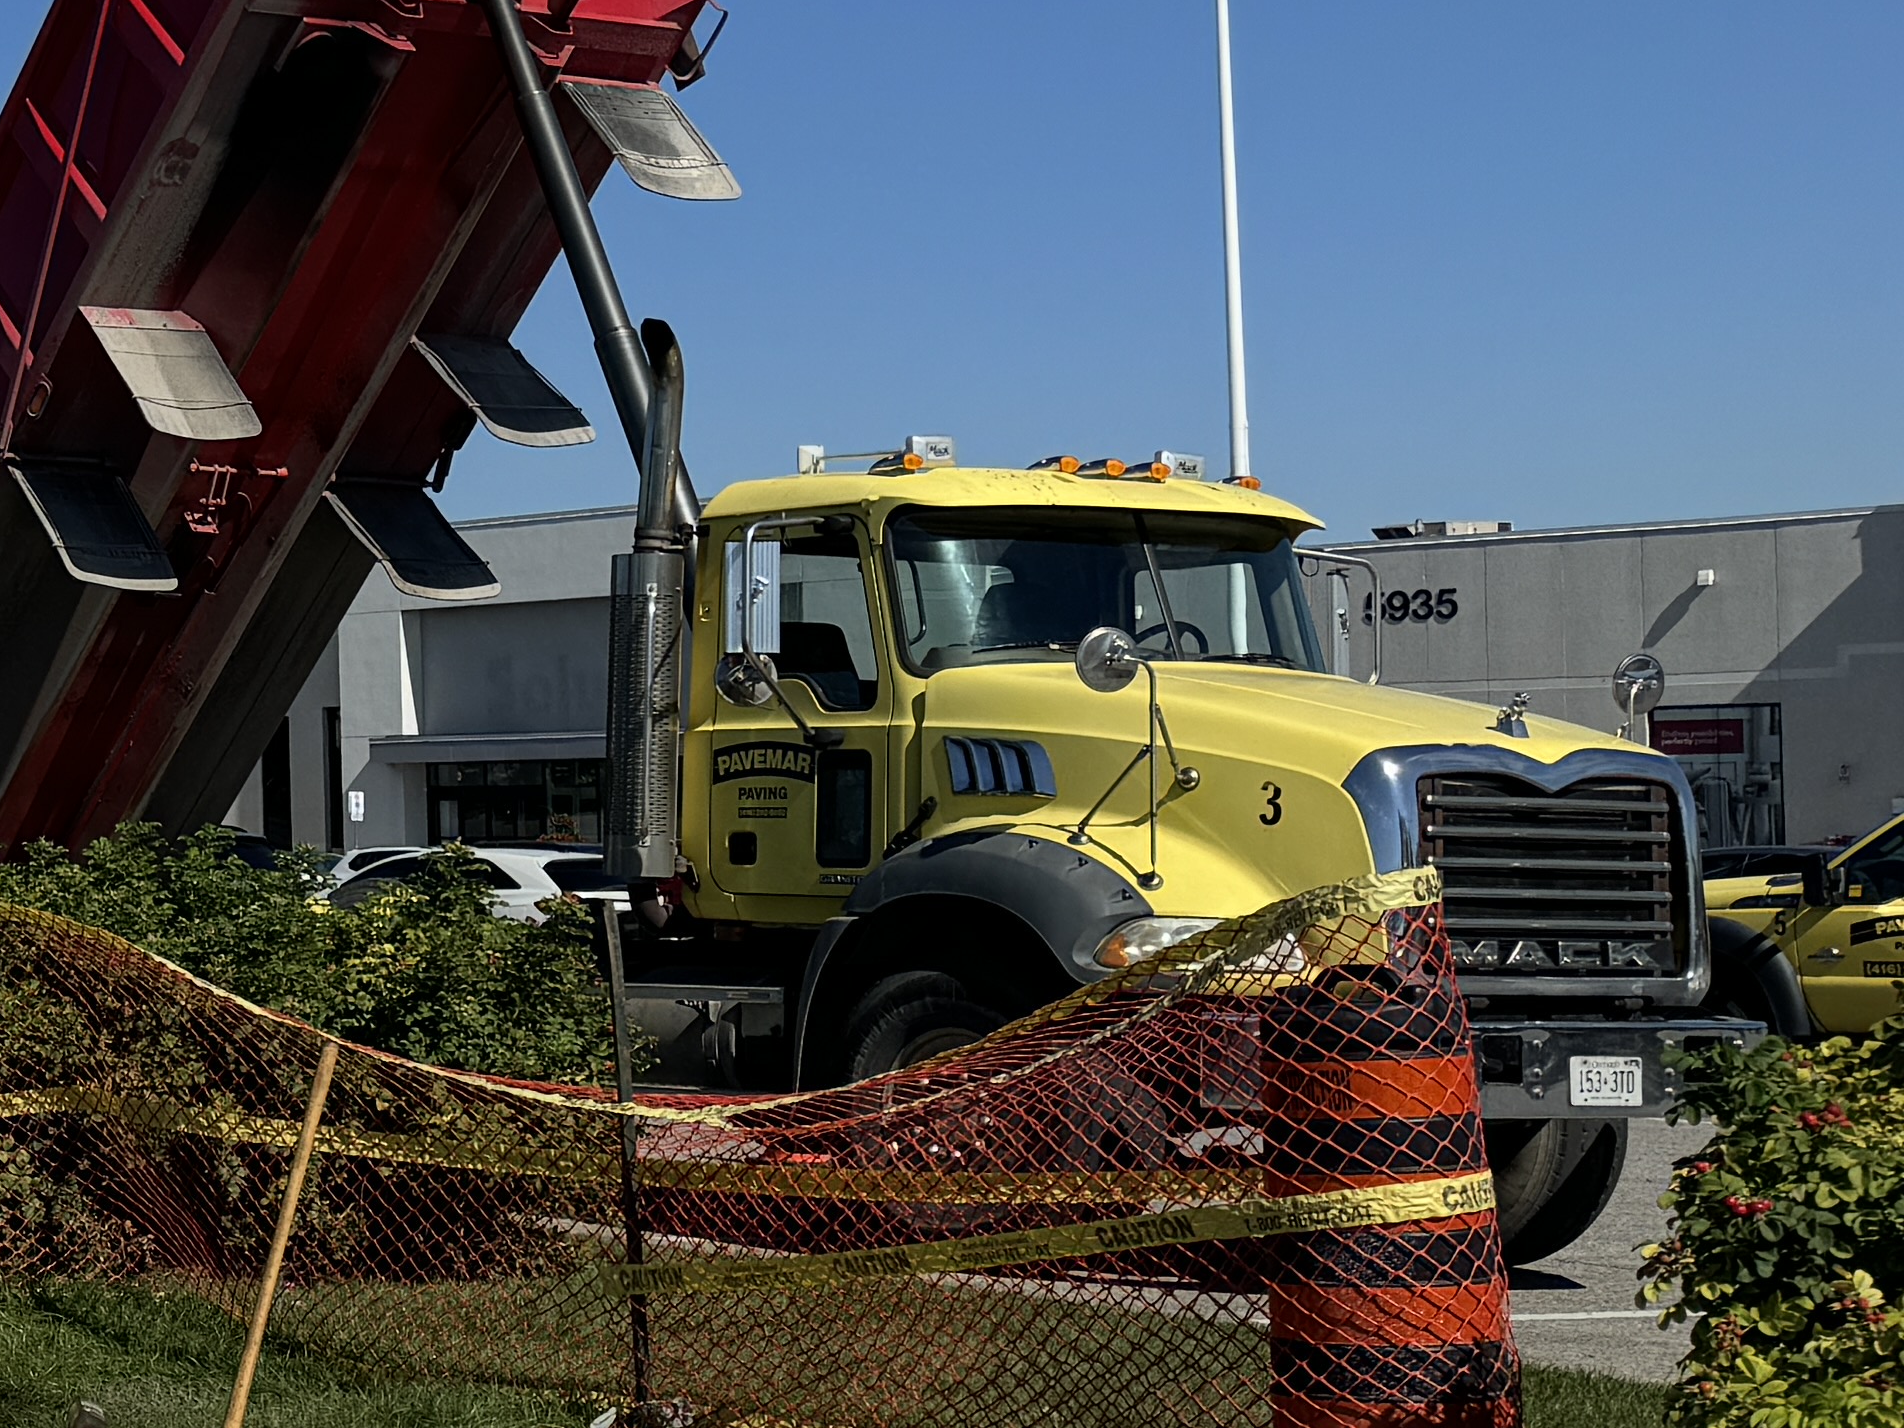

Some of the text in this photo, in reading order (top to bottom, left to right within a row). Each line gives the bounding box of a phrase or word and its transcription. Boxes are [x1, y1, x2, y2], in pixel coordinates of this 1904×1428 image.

[1364, 588, 1458, 622] 5935
[717, 749, 811, 775] PAVEMAR
[738, 787, 787, 800] PAVING
[1259, 781, 1282, 825] 3
[1774, 910, 1786, 935] 5
[1449, 941, 1660, 968] MACK
[1579, 1071, 1601, 1093] 153
[1094, 1214, 1196, 1248] CAUTION
[833, 1249, 912, 1277] CAUTION
[620, 1268, 685, 1290] CAUTION
